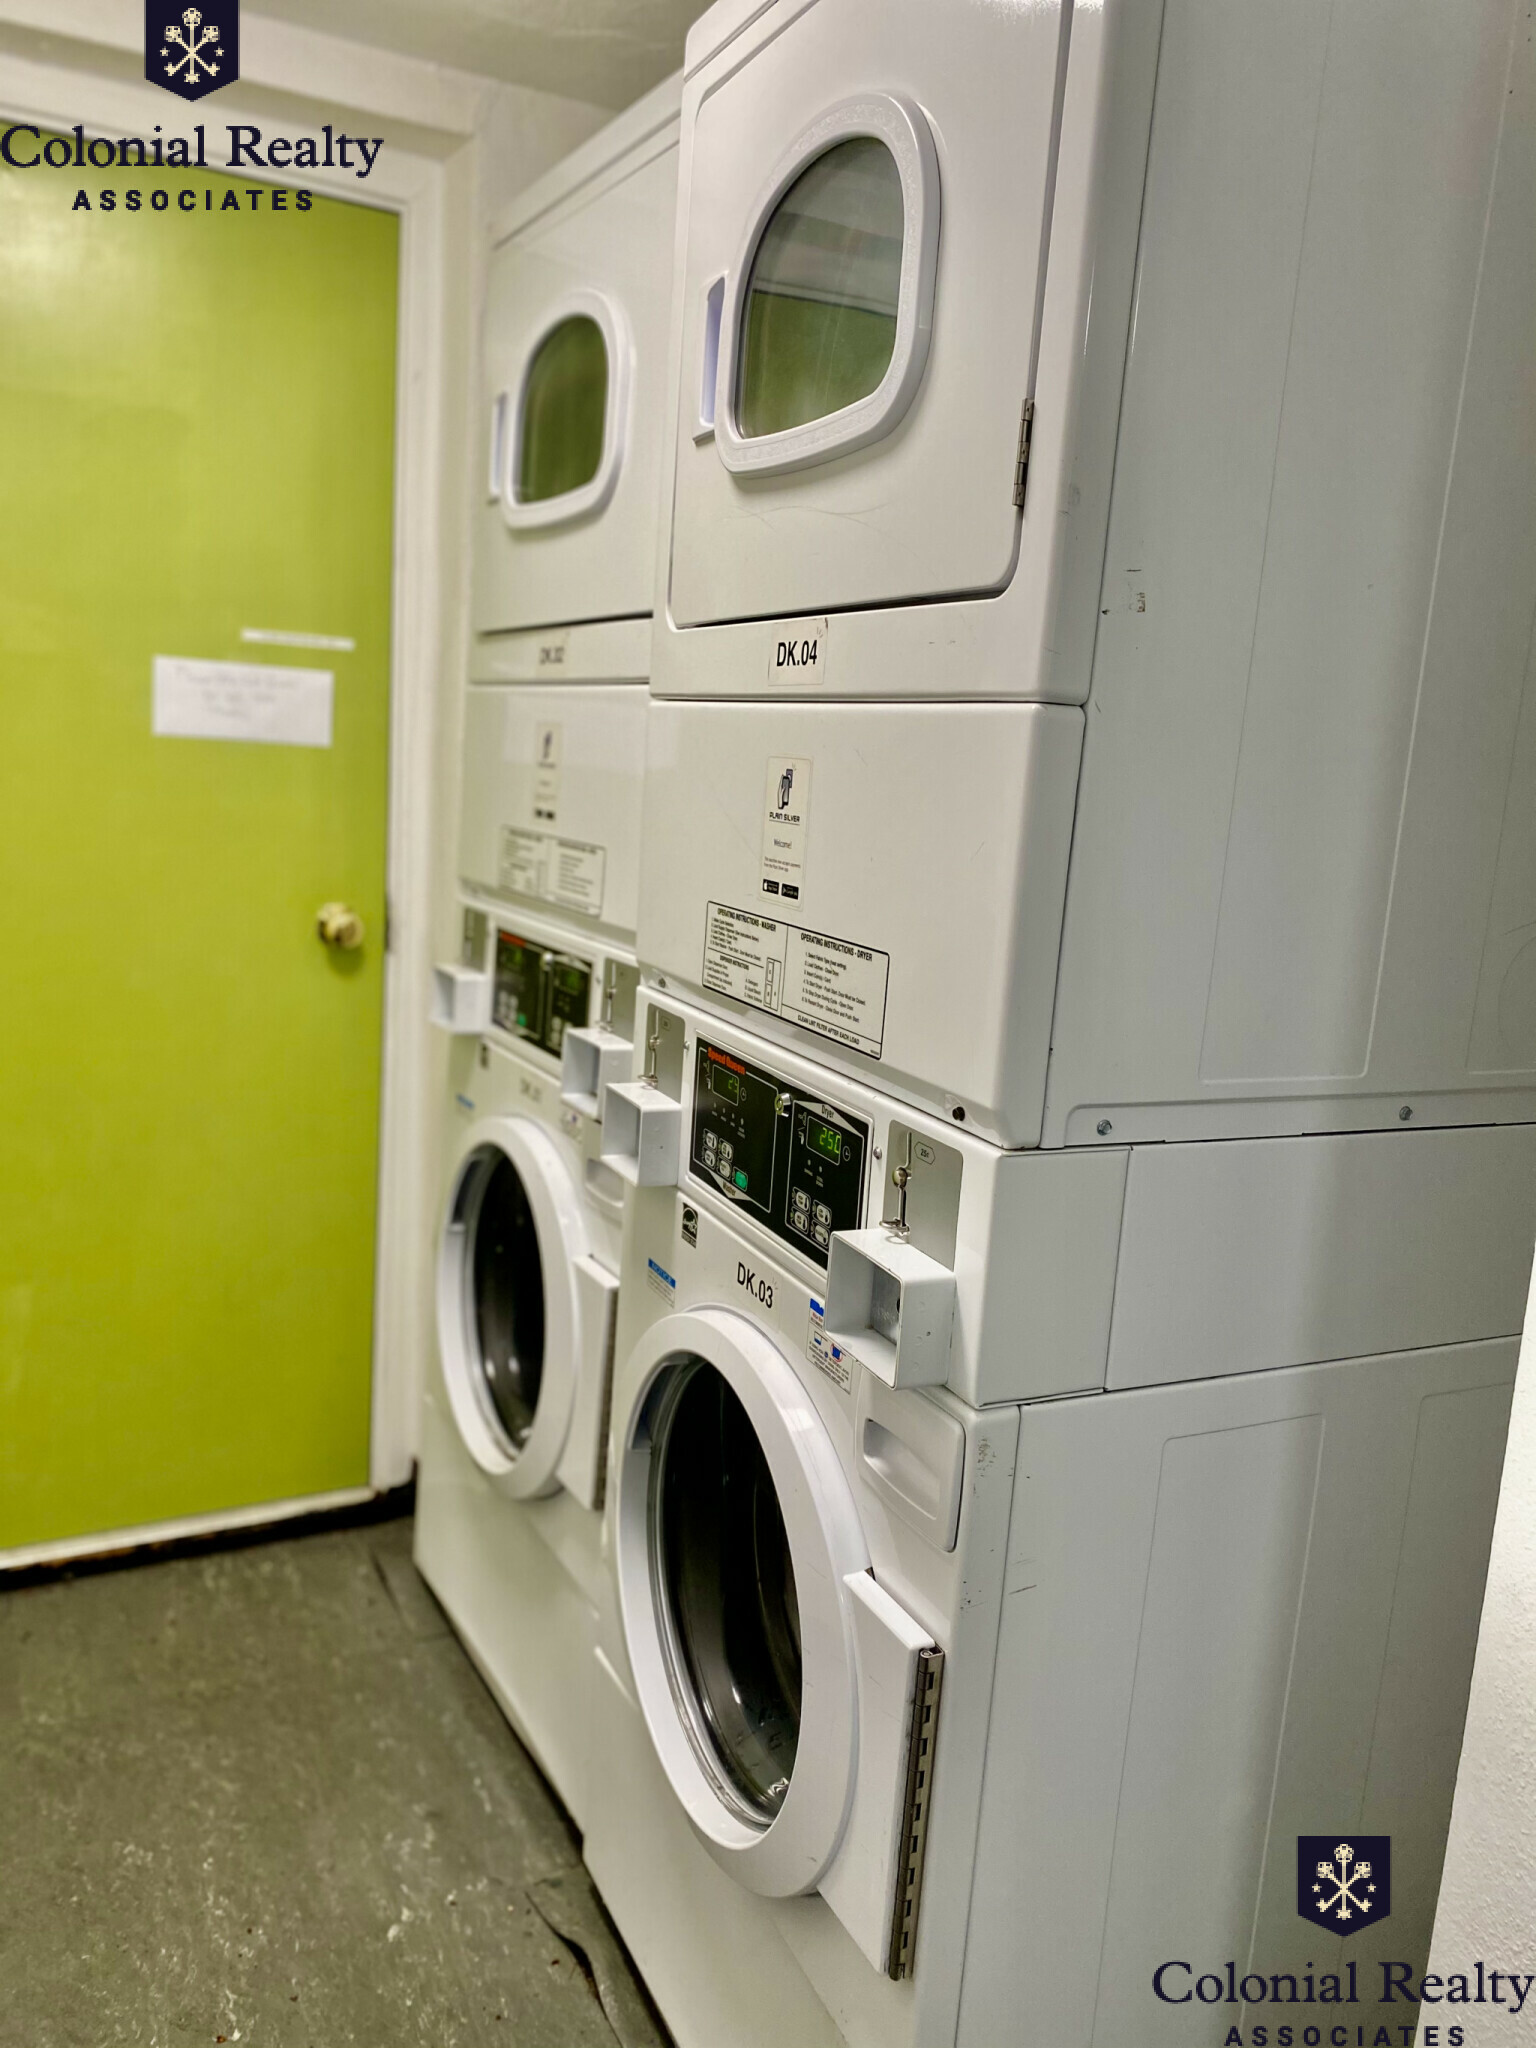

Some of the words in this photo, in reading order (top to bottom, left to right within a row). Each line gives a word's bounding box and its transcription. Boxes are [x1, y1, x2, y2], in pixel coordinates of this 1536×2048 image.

[776, 639, 818, 667] DK.04
[762, 921, 776, 932] WASHER
[800, 932, 824, 946] OPERATING
[824, 939, 854, 956] INSTRUCTIONS
[857, 949, 872, 962] DRYER
[798, 1014, 809, 1024] CLEAN
[816, 1022, 827, 1032] FILTER
[828, 1026, 839, 1036] AFTER
[840, 1032, 849, 1040] EACH
[821, 1104, 835, 1118] Dryer
[736, 1261, 774, 1309] DK.03
